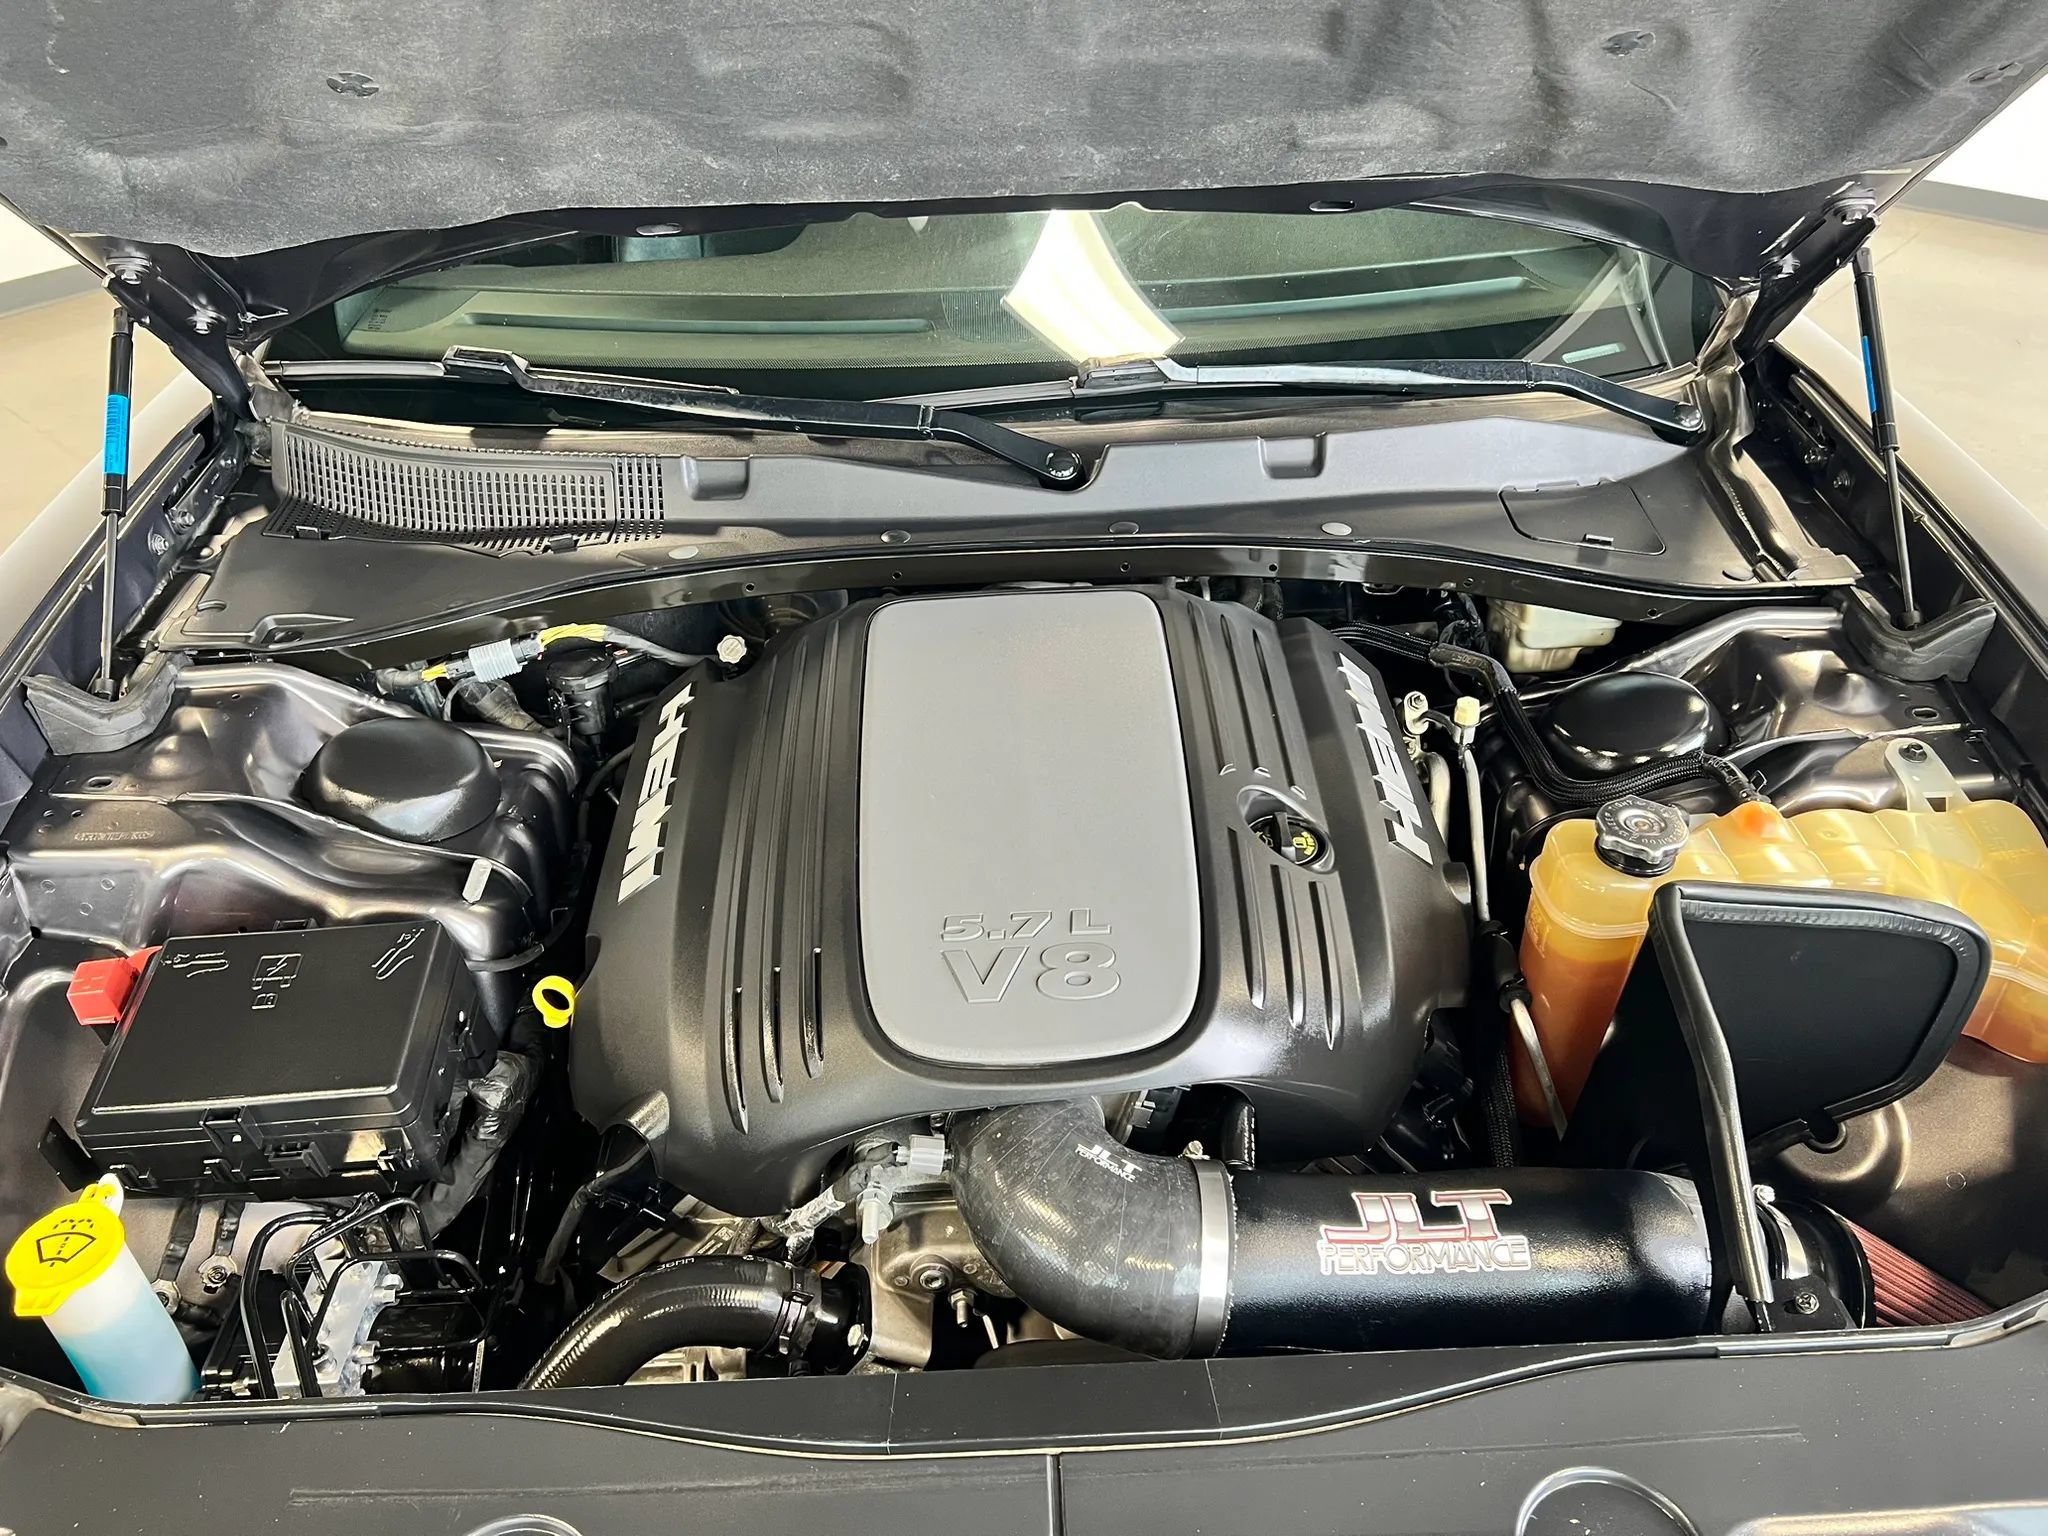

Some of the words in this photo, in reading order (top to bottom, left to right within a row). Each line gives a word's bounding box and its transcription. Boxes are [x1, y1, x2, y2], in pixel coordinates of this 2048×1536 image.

[1337, 652, 1434, 867] HEMI
[618, 683, 695, 904] HEMI
[940, 910, 1052, 942] 5.7
[1070, 907, 1112, 936] L
[940, 942, 1121, 1003] V8
[1075, 1146, 1136, 1183] PERFORMANCE
[1077, 1143, 1143, 1174] JLT
[1320, 1188, 1512, 1245] JLT
[1317, 1236, 1530, 1275] PERFORMANCE
